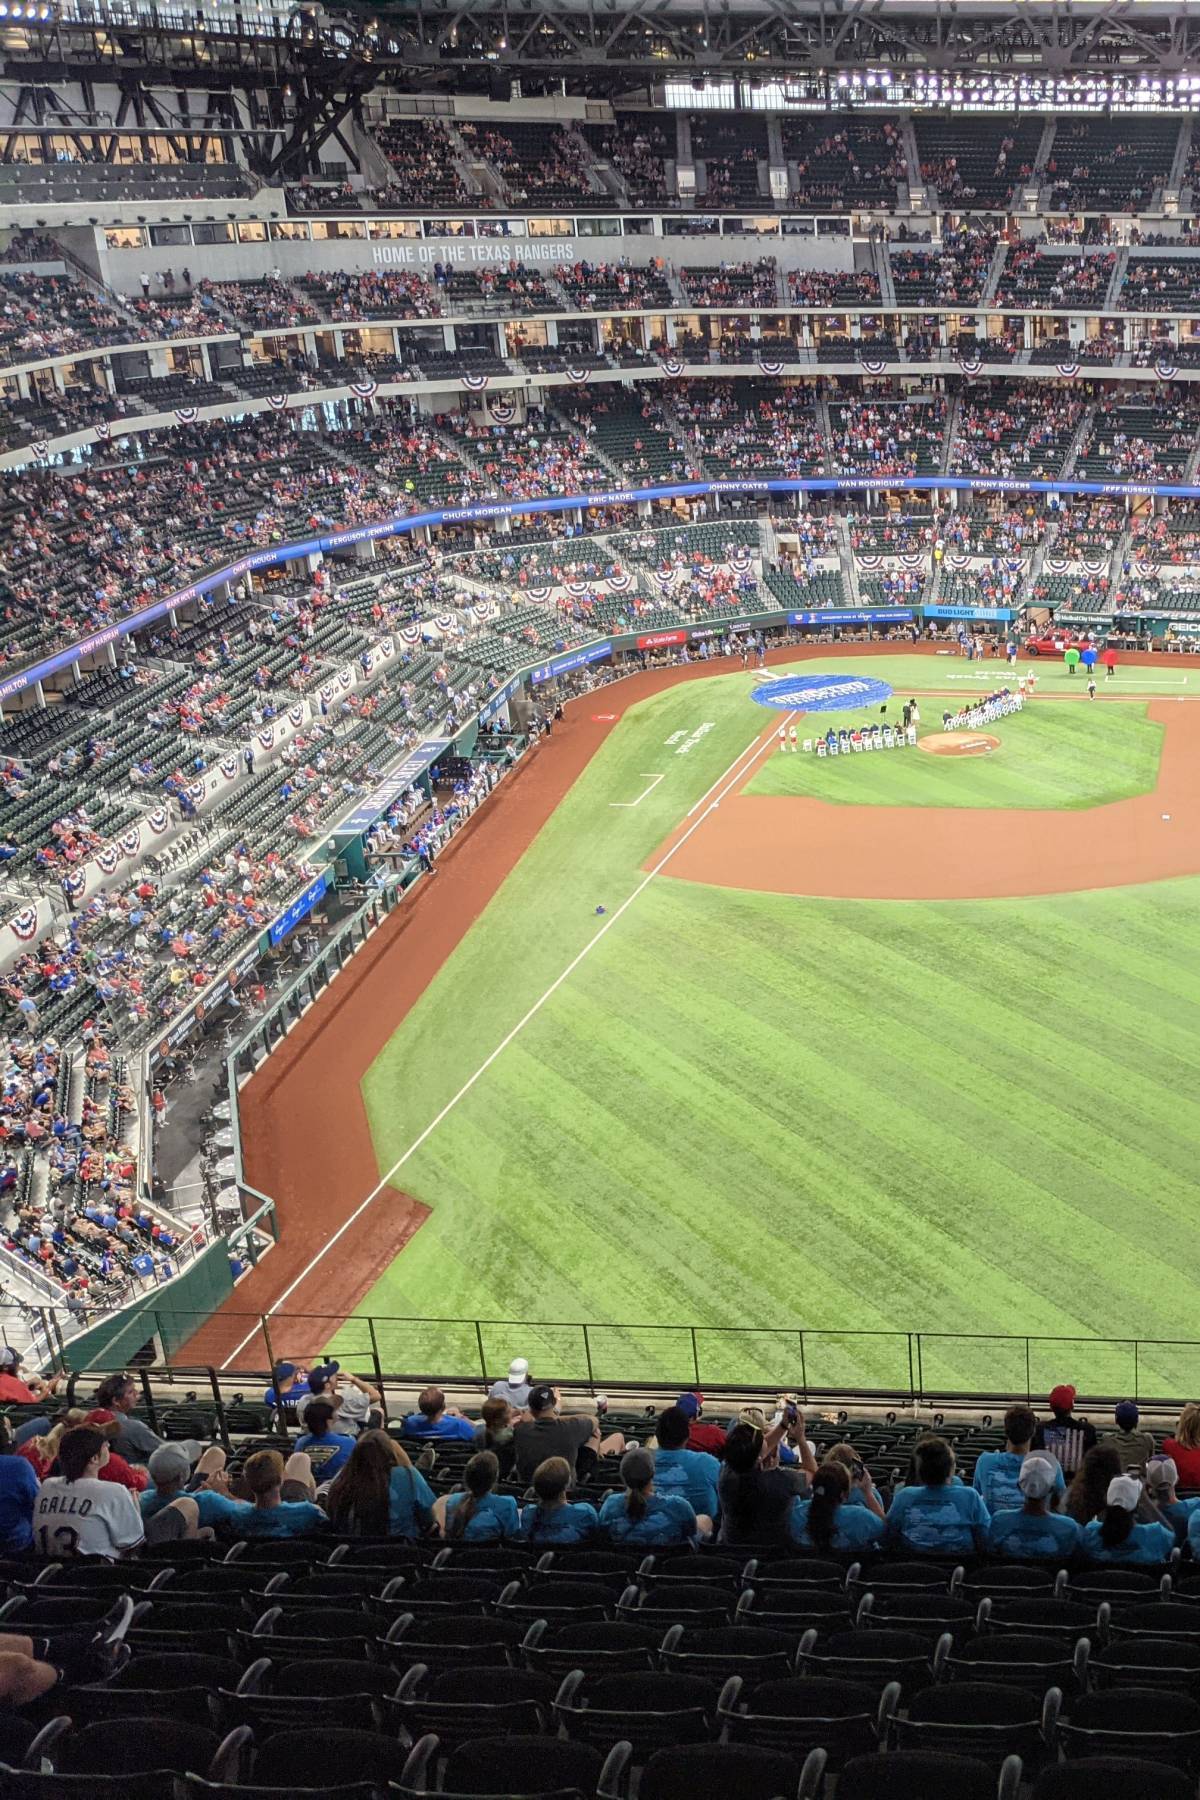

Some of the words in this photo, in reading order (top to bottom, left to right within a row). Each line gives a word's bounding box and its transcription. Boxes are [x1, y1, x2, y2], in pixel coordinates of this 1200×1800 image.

[372, 246, 414, 264] HOME
[419, 246, 438, 263] OF
[440, 245, 466, 262] THE
[469, 244, 511, 261] TEXAS
[515, 243, 575, 260] RANGERS
[708, 482, 741, 491] JOHNNY
[741, 482, 769, 490] OATES
[970, 480, 997, 488] KENNY
[998, 481, 1031, 489] ROGERS
[1102, 485, 1120, 493] JEFF
[1122, 486, 1158, 494] RUSSELL
[588, 496, 607, 504] ERIC
[608, 493, 635, 502] NADEL
[442, 511, 473, 520] CHUCK
[474, 506, 512, 517] MORGAN
[329, 532, 366, 546] FERGUSON
[366, 524, 395, 539] JENKINS
[252, 553, 277, 567] HOUGH
[953, 608, 975, 616] LIGHT
[79, 642, 95, 655] TOBY
[39, 1496, 93, 1517] GALLO
